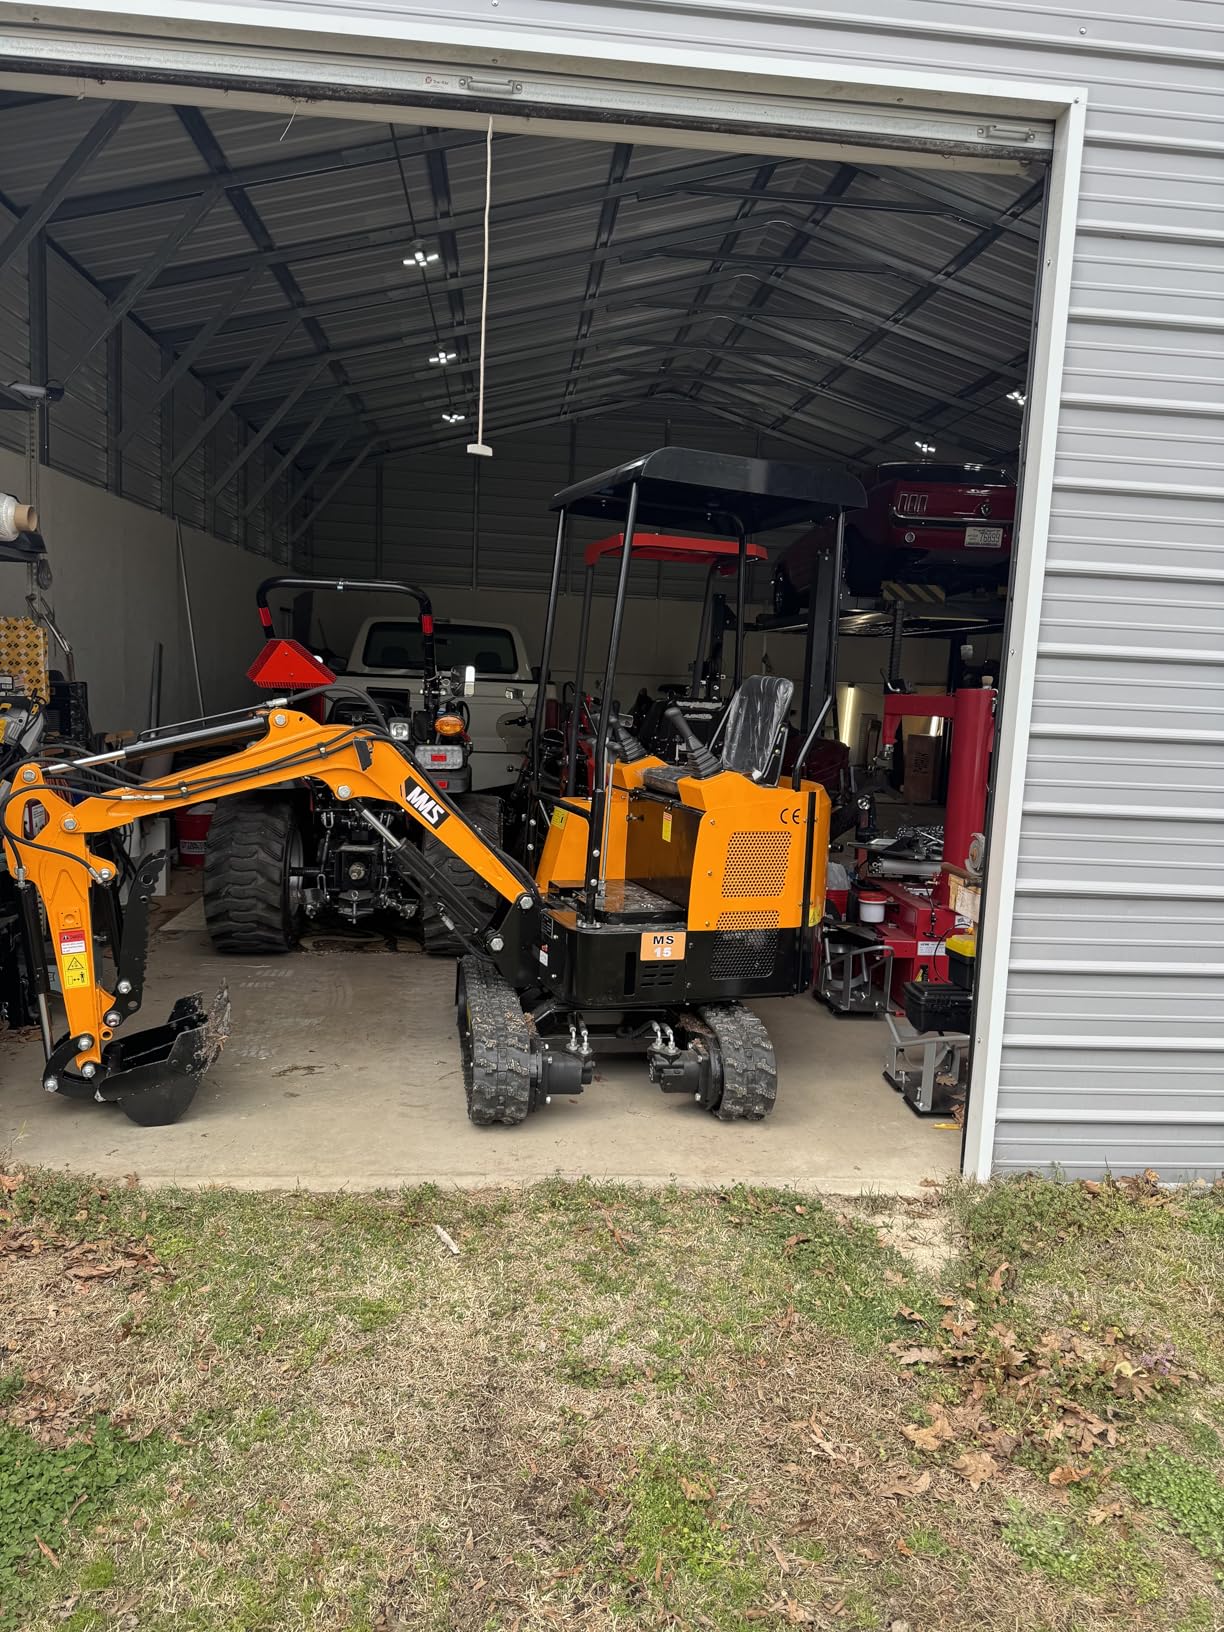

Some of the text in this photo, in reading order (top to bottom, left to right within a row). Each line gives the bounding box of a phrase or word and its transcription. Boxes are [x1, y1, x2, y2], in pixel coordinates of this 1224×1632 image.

[406, 786, 445, 825] MMS
[780, 808, 801, 824] CE
[653, 935, 674, 945] MS
[654, 946, 672, 958] 15
